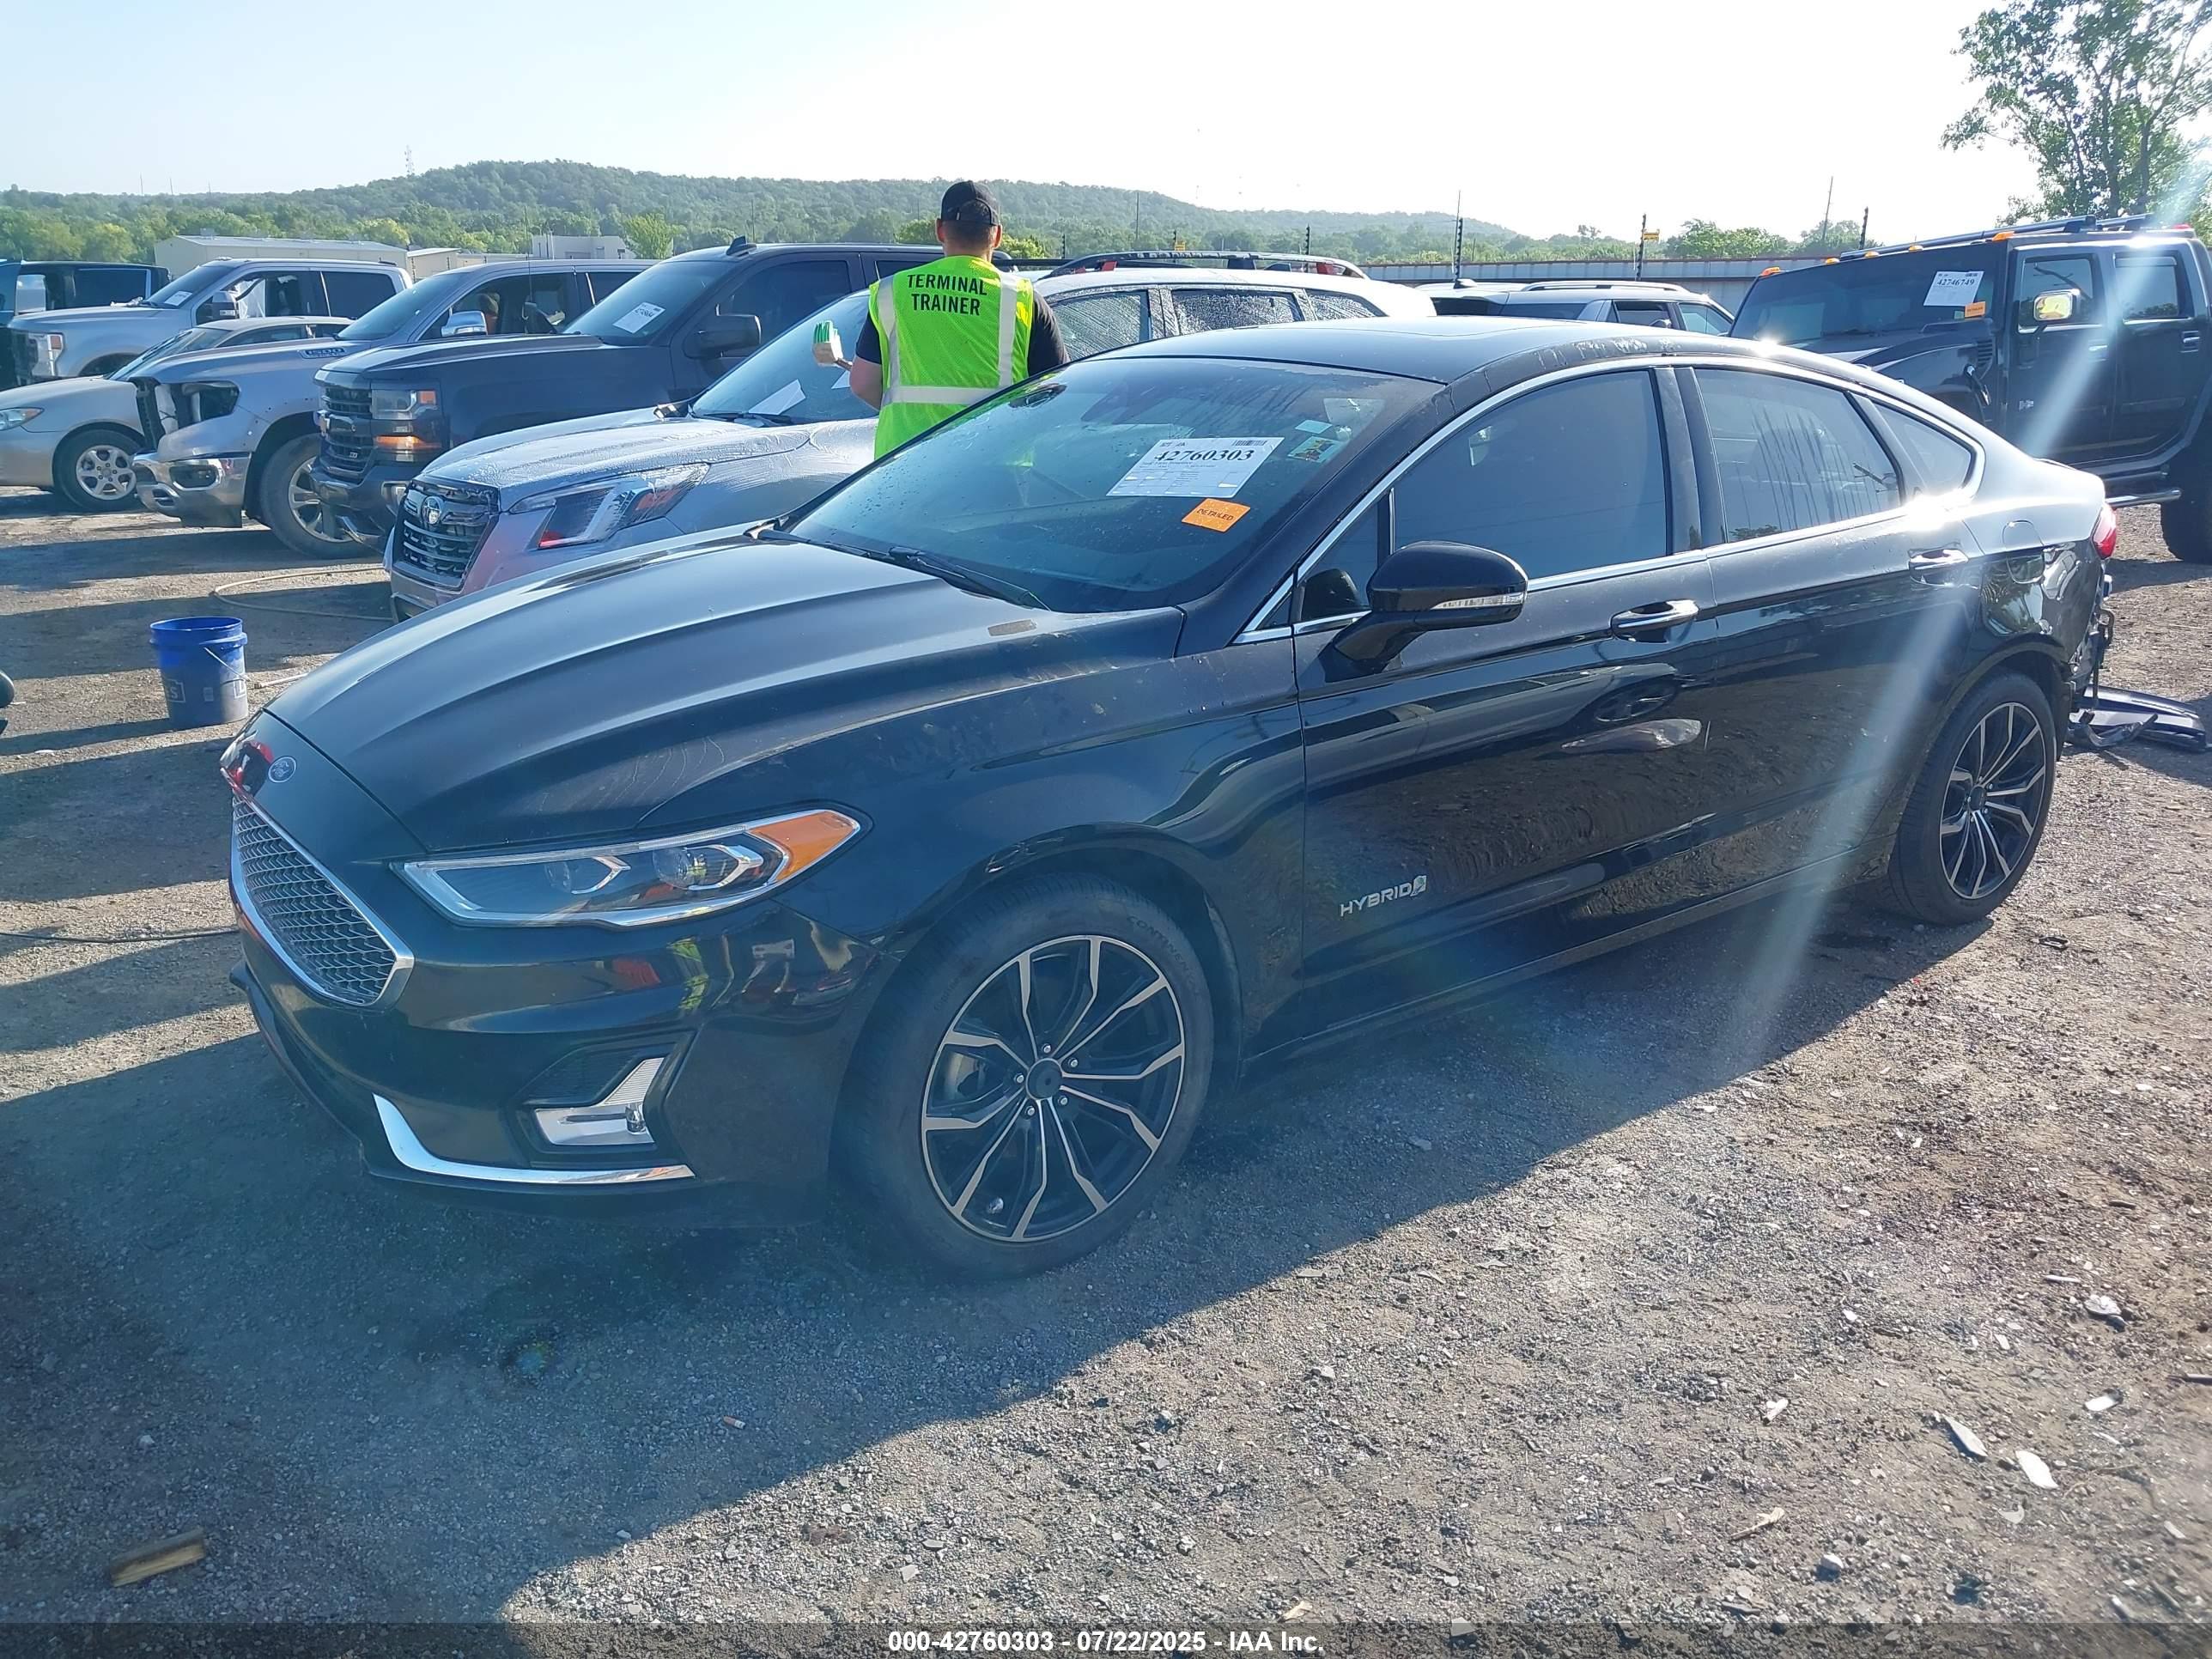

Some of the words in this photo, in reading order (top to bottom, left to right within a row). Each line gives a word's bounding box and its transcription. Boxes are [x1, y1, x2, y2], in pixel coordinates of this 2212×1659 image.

[908, 274, 988, 296] TERMINAL
[911, 293, 981, 316] TRAINER
[1154, 449, 1255, 461] 42760303
[1196, 507, 1234, 521] DETAILED
[1340, 882, 1413, 917] HYBRID
